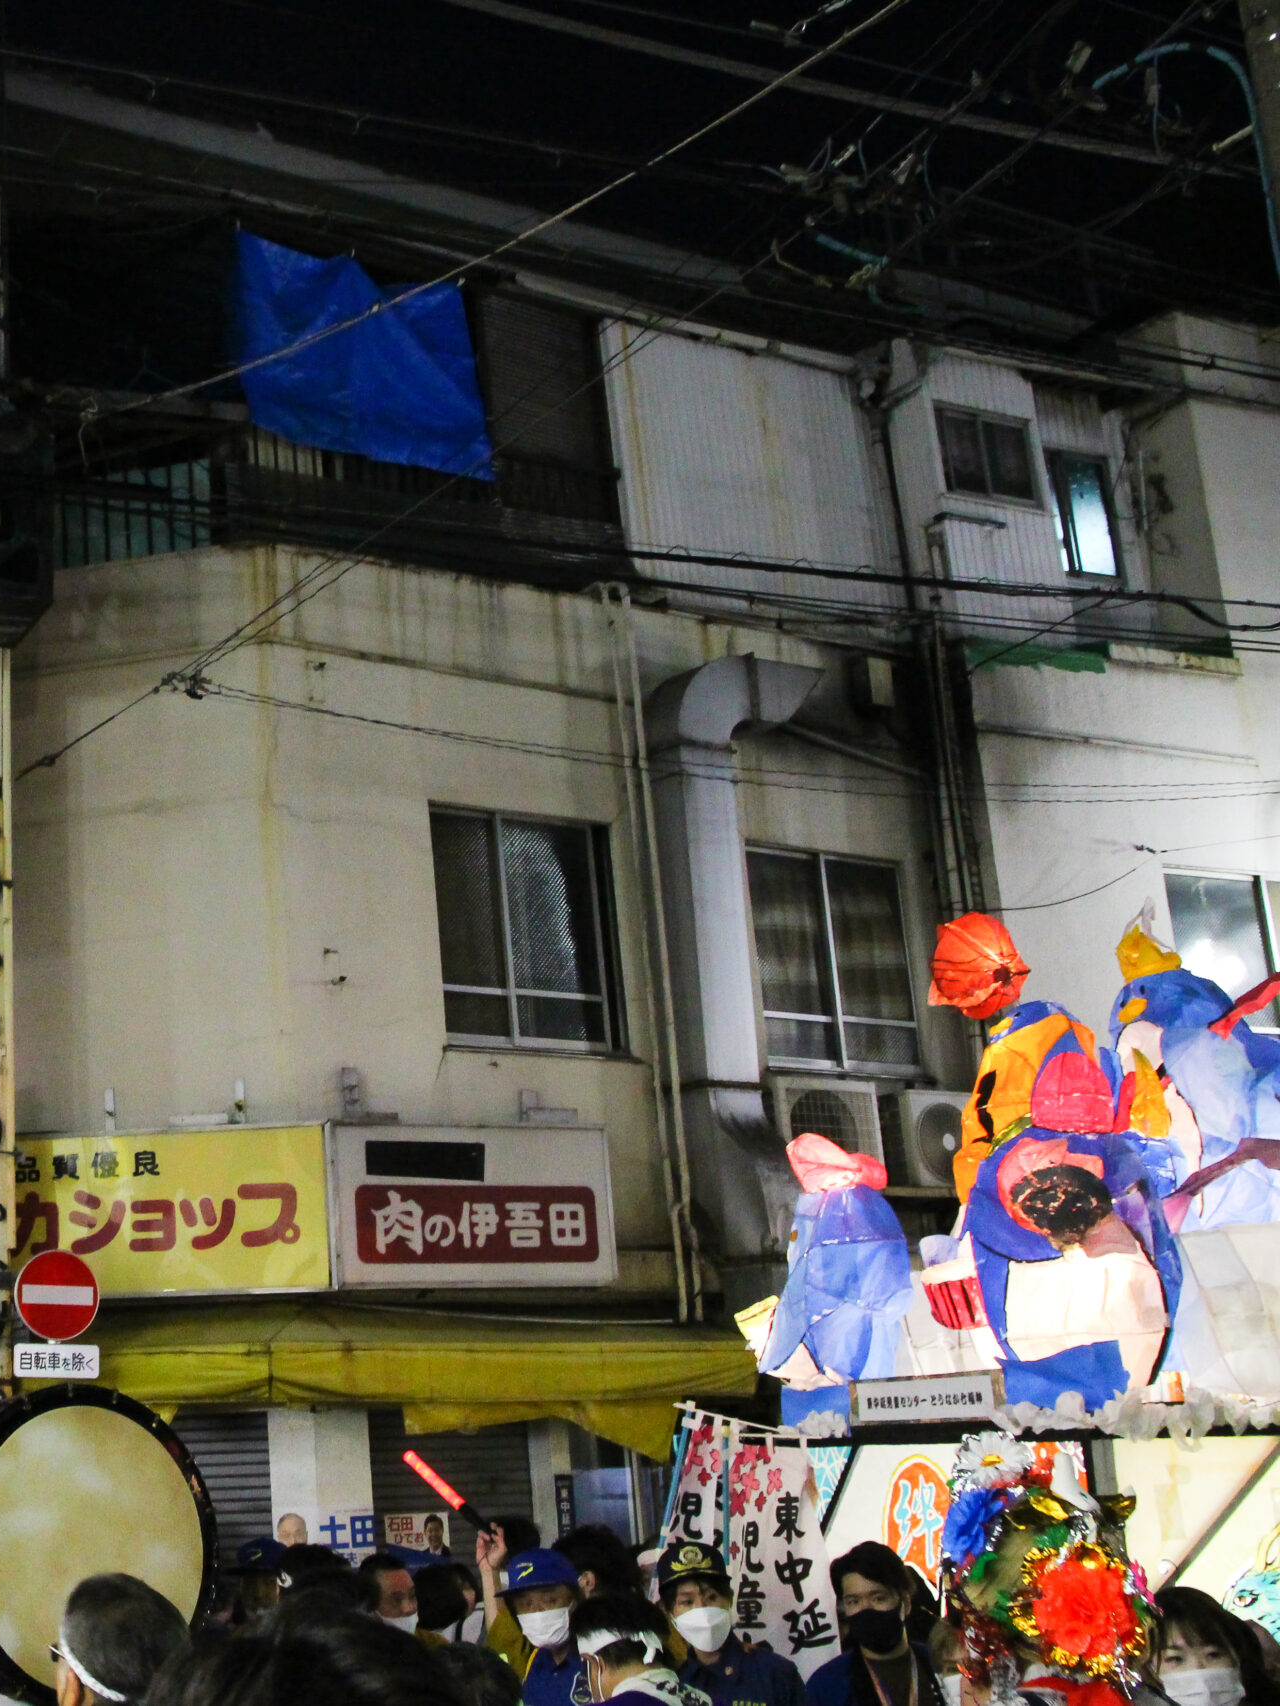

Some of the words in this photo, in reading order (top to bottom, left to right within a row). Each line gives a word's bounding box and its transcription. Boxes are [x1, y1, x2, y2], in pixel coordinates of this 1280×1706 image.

[15, 1150, 161, 1182] 品質優良
[370, 1190, 588, 1256] 肉の伊吾田
[20, 1351, 95, 1372] 自転車を除く
[320, 1515, 376, 1549] 土田
[387, 1516, 413, 1532] 石田
[670, 1492, 704, 1545] 児
[894, 1476, 944, 1563] 絆
[394, 1533, 424, 1545] ひでお
[773, 1491, 837, 1656] 東中延
